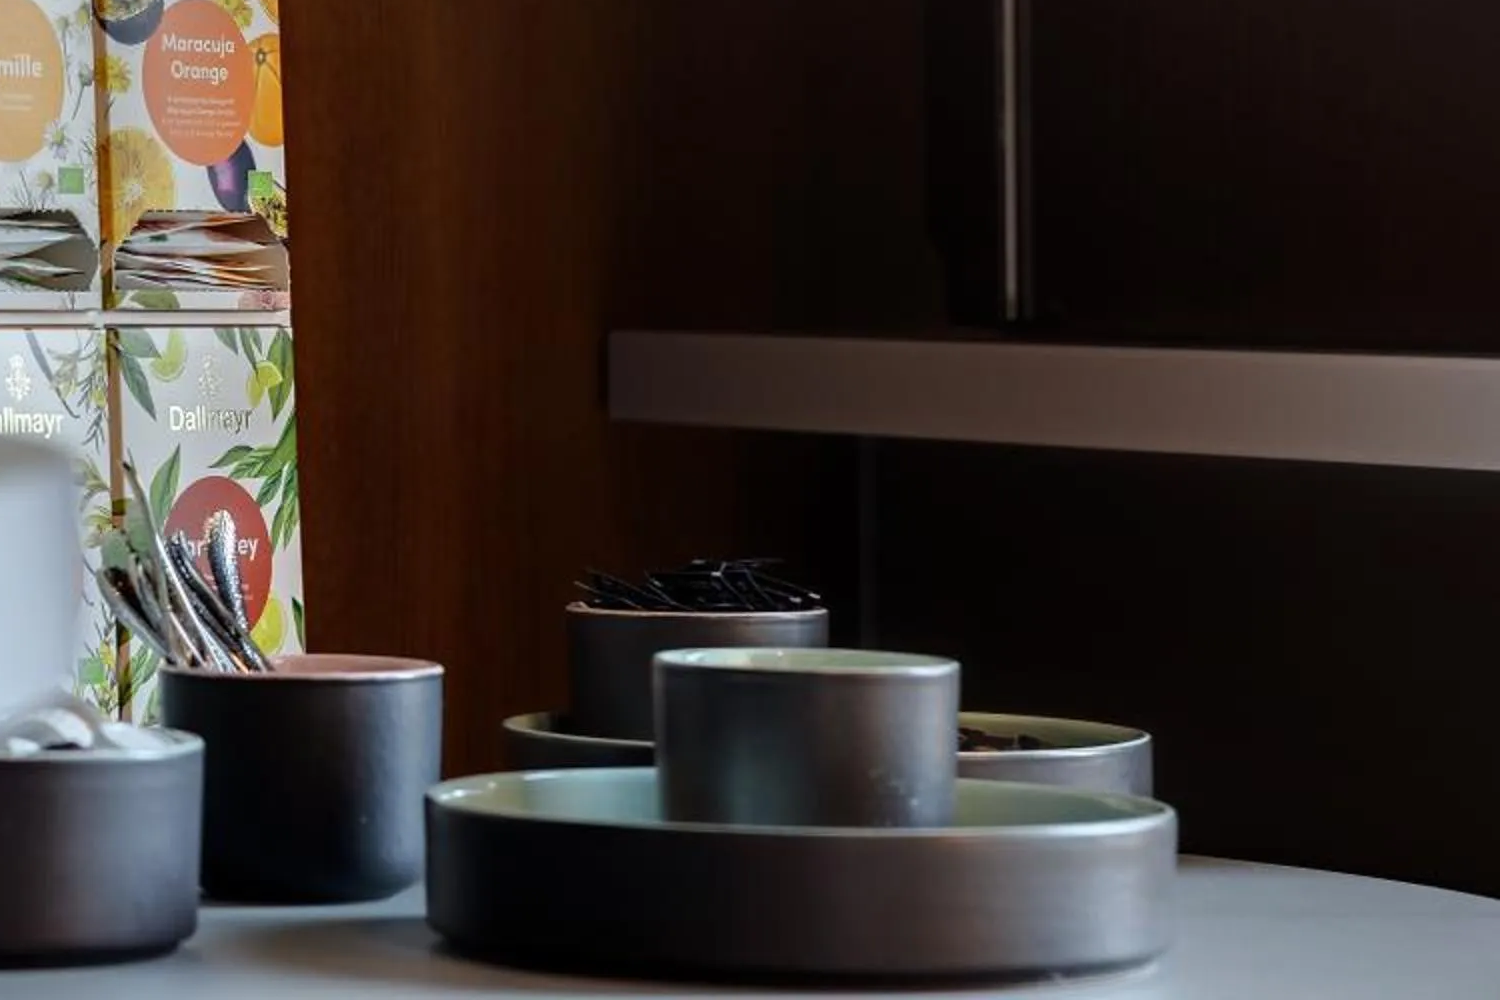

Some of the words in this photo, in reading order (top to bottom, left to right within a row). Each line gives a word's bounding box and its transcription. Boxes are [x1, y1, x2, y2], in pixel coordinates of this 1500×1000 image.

[161, 33, 235, 58] Maracuja
[170, 60, 229, 85] Orange
[169, 405, 253, 436] Dallmayr
